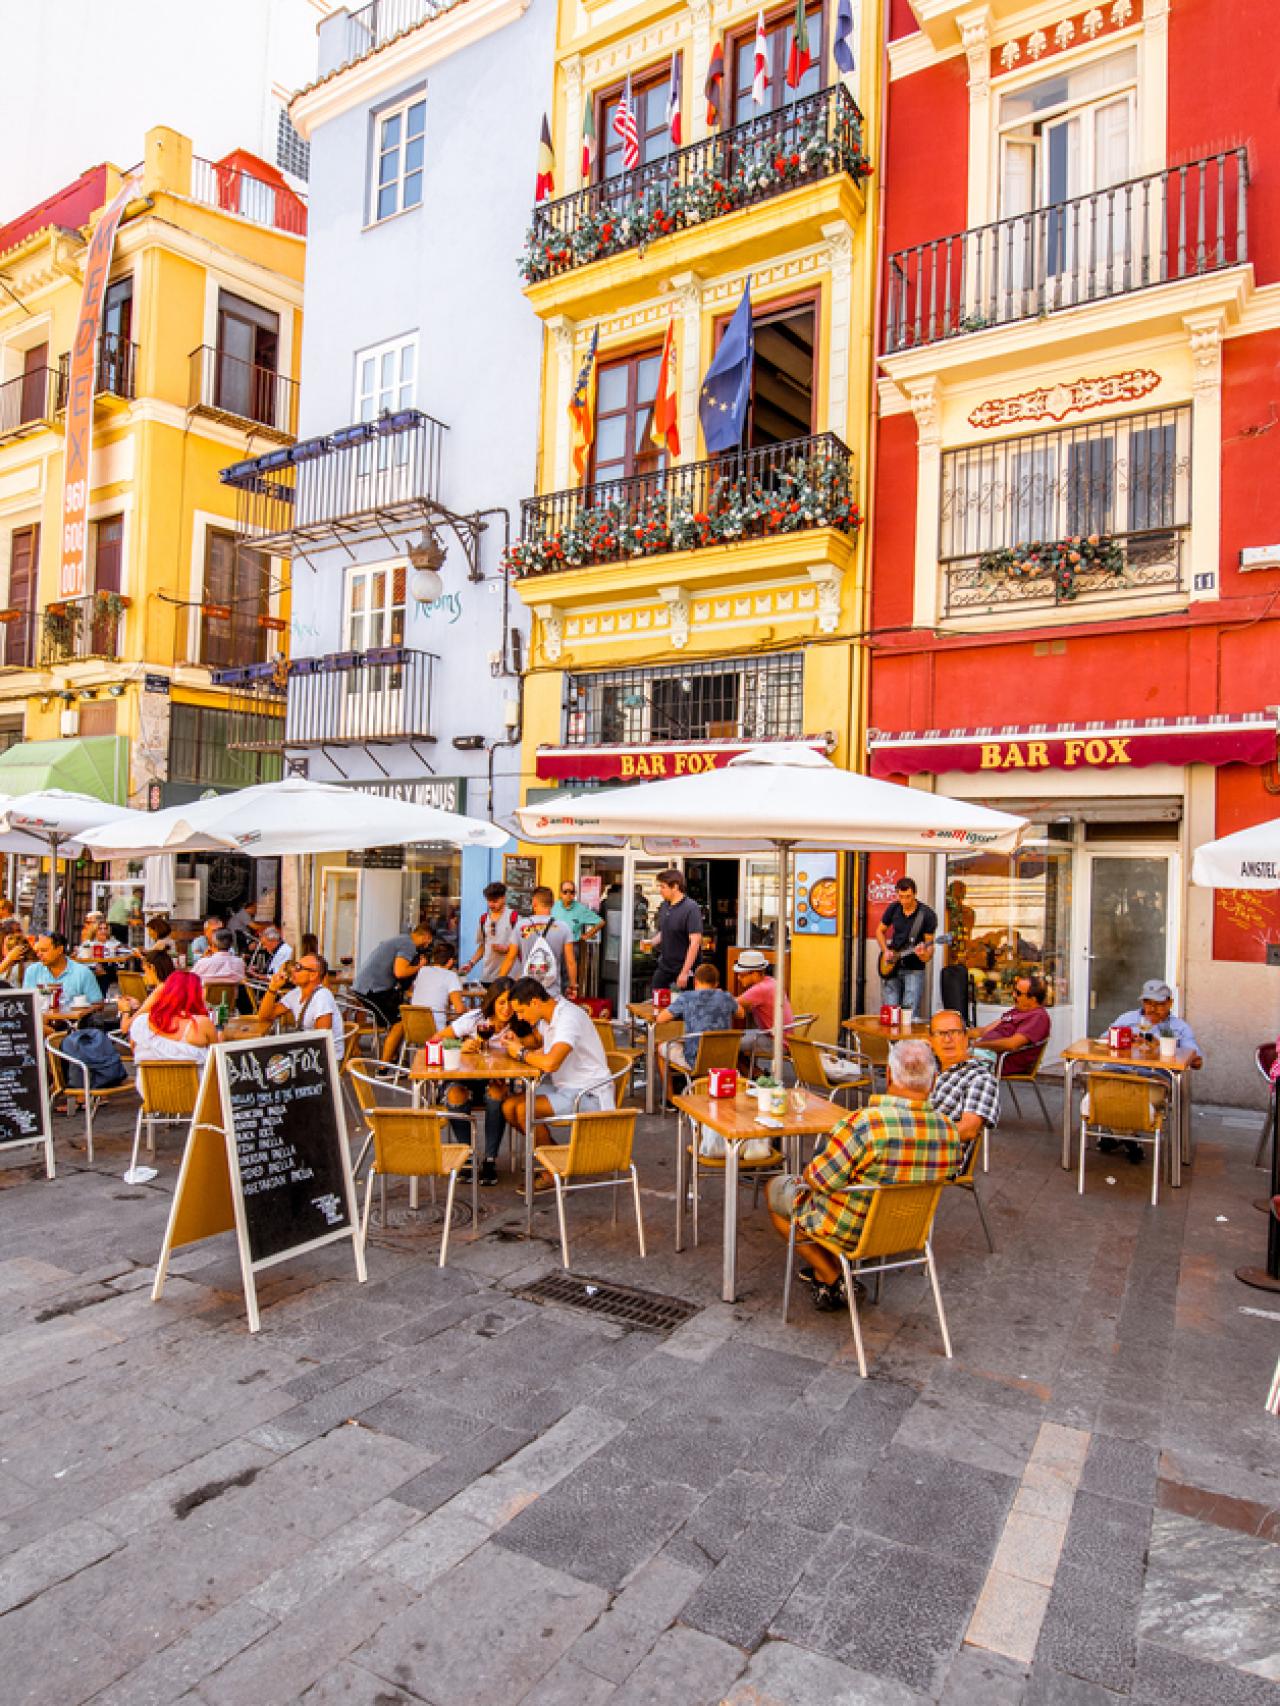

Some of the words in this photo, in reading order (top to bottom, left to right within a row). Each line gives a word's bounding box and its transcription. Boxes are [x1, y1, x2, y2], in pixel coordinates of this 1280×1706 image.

[69, 219, 116, 470] MEDEX
[621, 754, 667, 776] BAR
[675, 752, 718, 775] FOX
[979, 742, 1051, 769] BAR
[1063, 738, 1132, 766] FOX
[415, 782, 456, 811] MENUS
[287, 1047, 324, 1079] FOX
